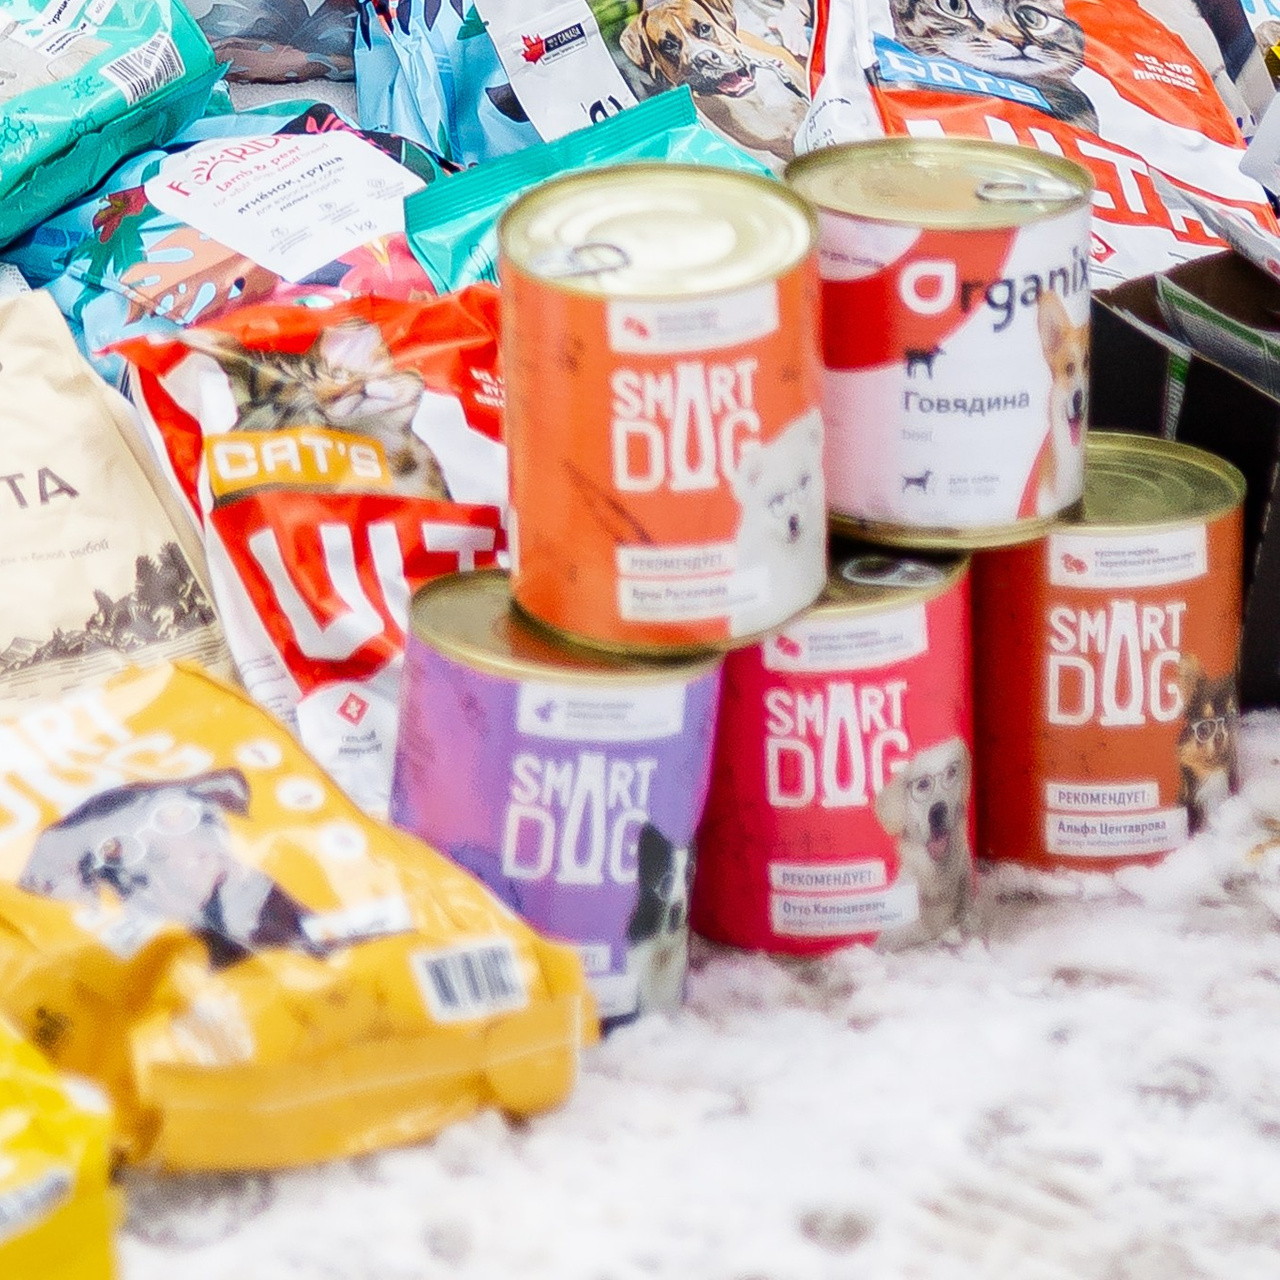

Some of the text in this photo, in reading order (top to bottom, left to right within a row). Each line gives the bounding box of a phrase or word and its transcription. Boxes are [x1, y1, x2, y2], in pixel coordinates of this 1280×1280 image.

[610, 357, 760, 420] SMART
[903, 390, 1032, 418] Говядина
[212, 436, 384, 481] CAT'S
[1048, 599, 1187, 654] SMART
[763, 678, 908, 739] SMART
[1047, 648, 1185, 727] DOG
[511, 750, 658, 809] SMART
